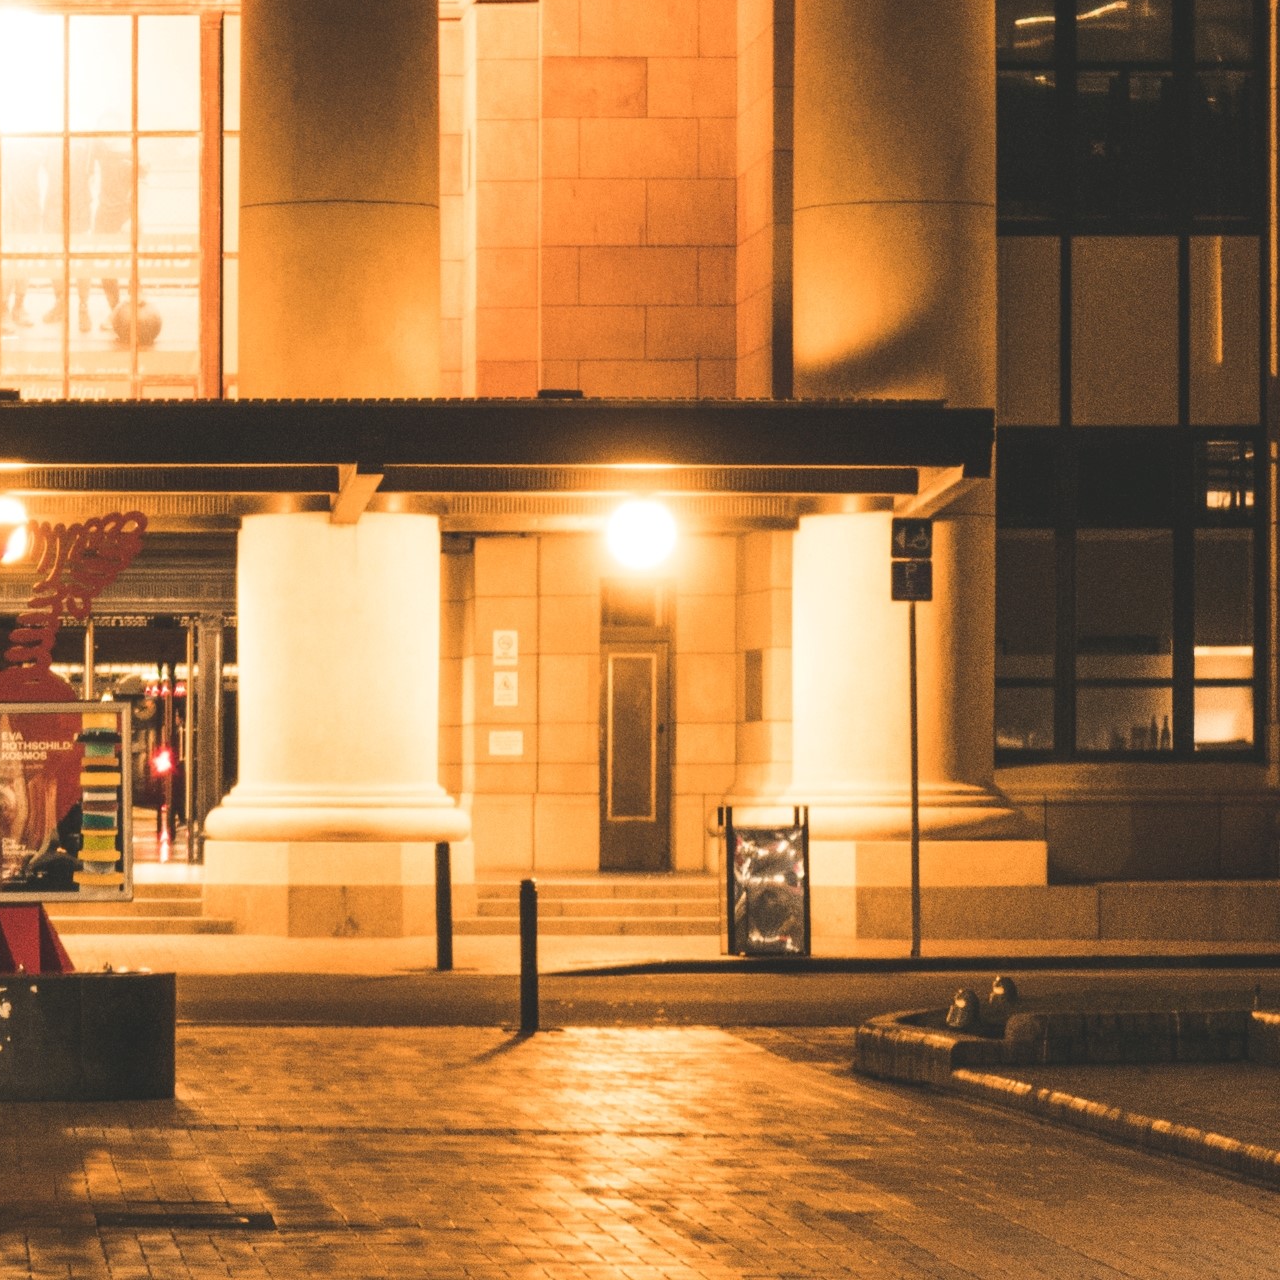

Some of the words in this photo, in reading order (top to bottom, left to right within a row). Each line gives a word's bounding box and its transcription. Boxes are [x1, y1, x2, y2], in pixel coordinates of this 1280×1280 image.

[1, 731, 24, 741] EVA
[1, 741, 74, 751] ROTHSCHILD:
[1, 751, 48, 760] KOSMOS
